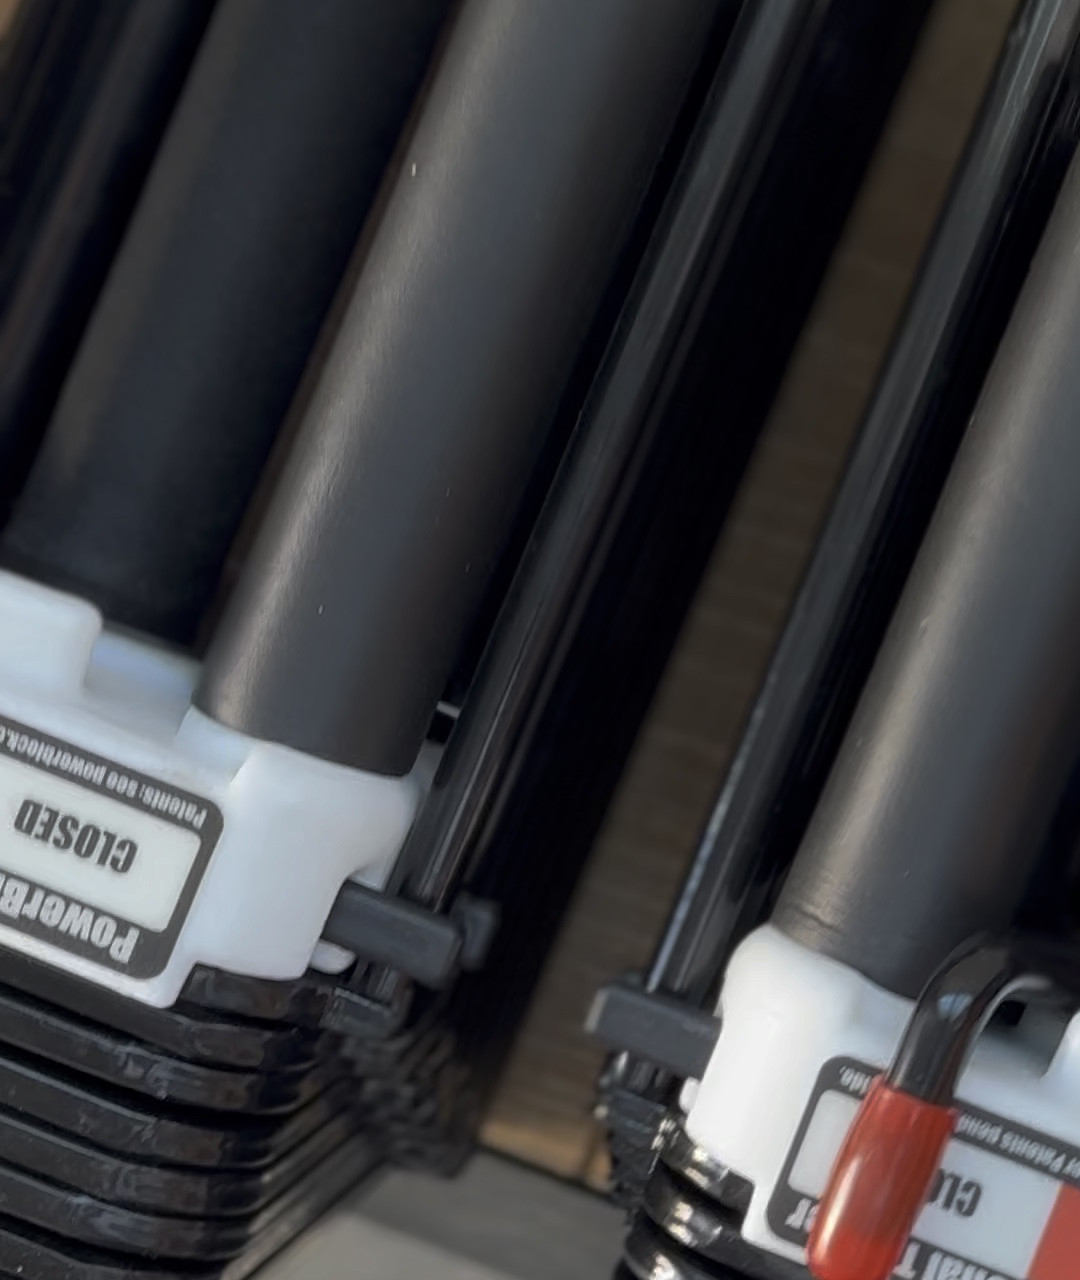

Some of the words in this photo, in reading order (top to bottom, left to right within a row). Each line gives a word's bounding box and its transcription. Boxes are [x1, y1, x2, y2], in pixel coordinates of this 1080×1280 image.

[105, 771, 138, 799] see
[139, 784, 208, 829] Patents:
[14, 798, 138, 873] CLOSED
[0, 873, 140, 963] PowerB
